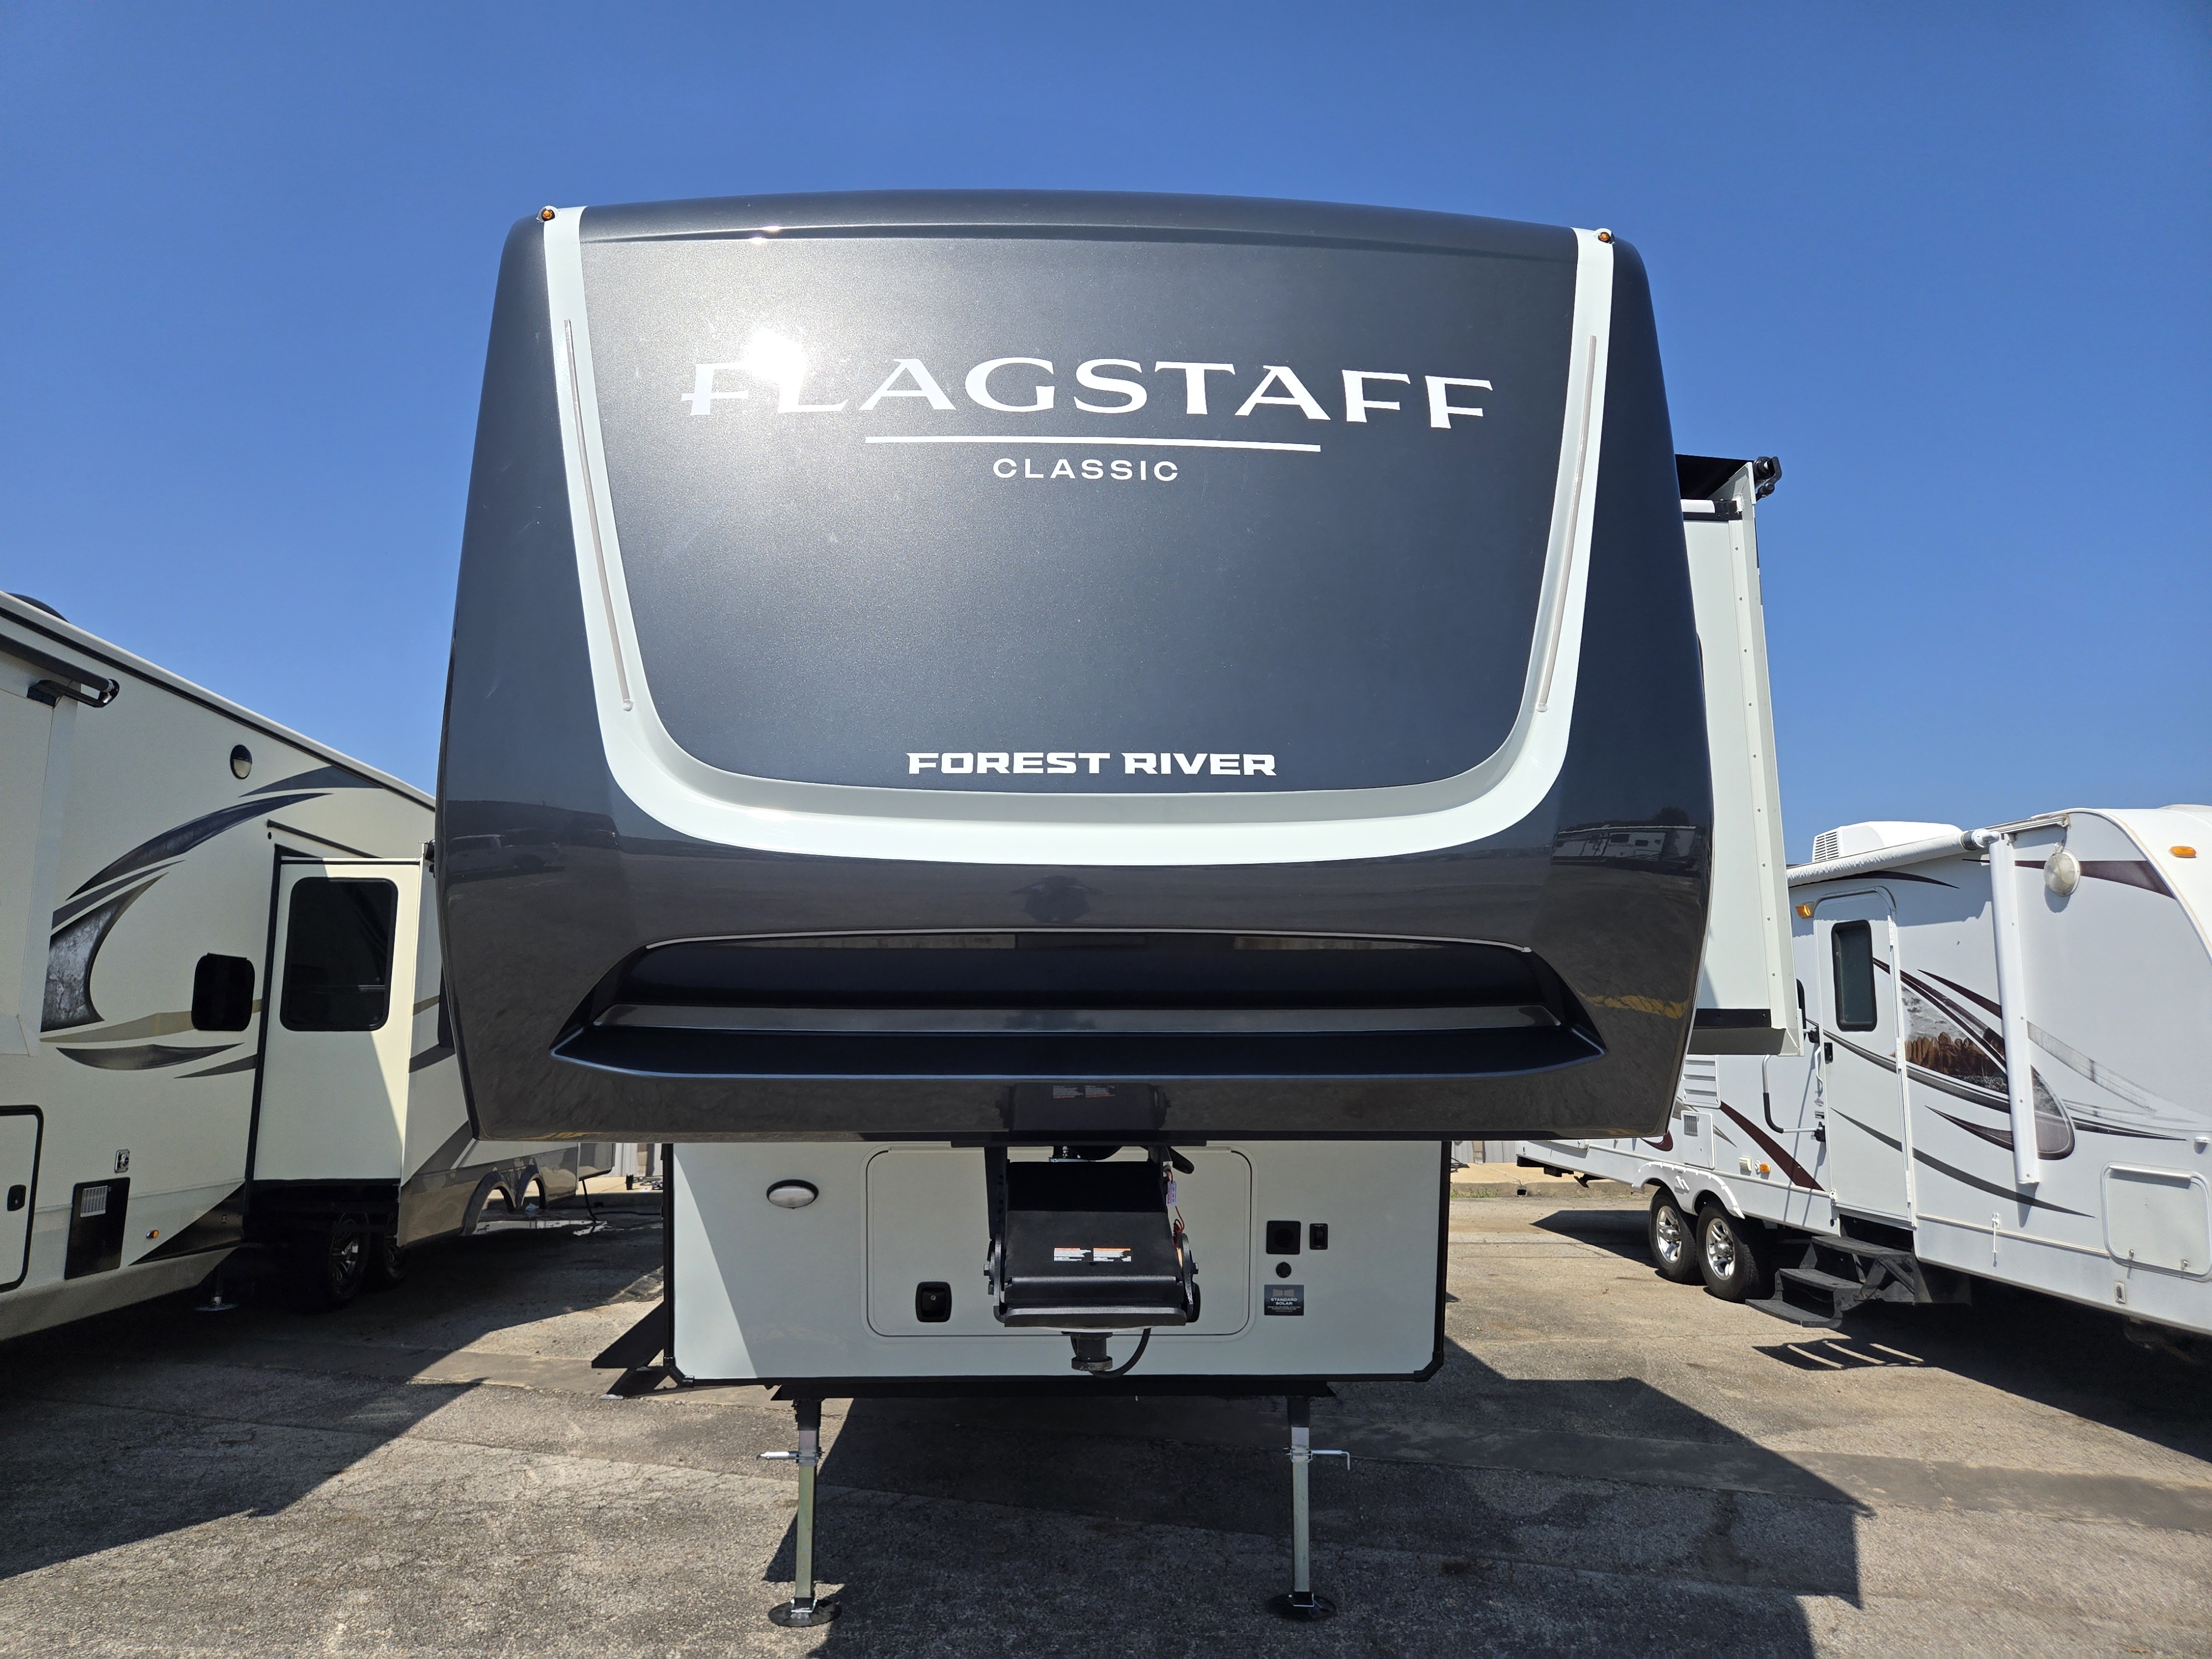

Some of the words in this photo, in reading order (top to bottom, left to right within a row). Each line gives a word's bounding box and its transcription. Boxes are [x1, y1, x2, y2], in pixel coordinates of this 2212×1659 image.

[680, 356, 1493, 429] FLAGSTAFF
[993, 457, 1178, 482] CLASSIC
[906, 752, 1110, 774] FOREST
[1121, 753, 1277, 776] RIVER
